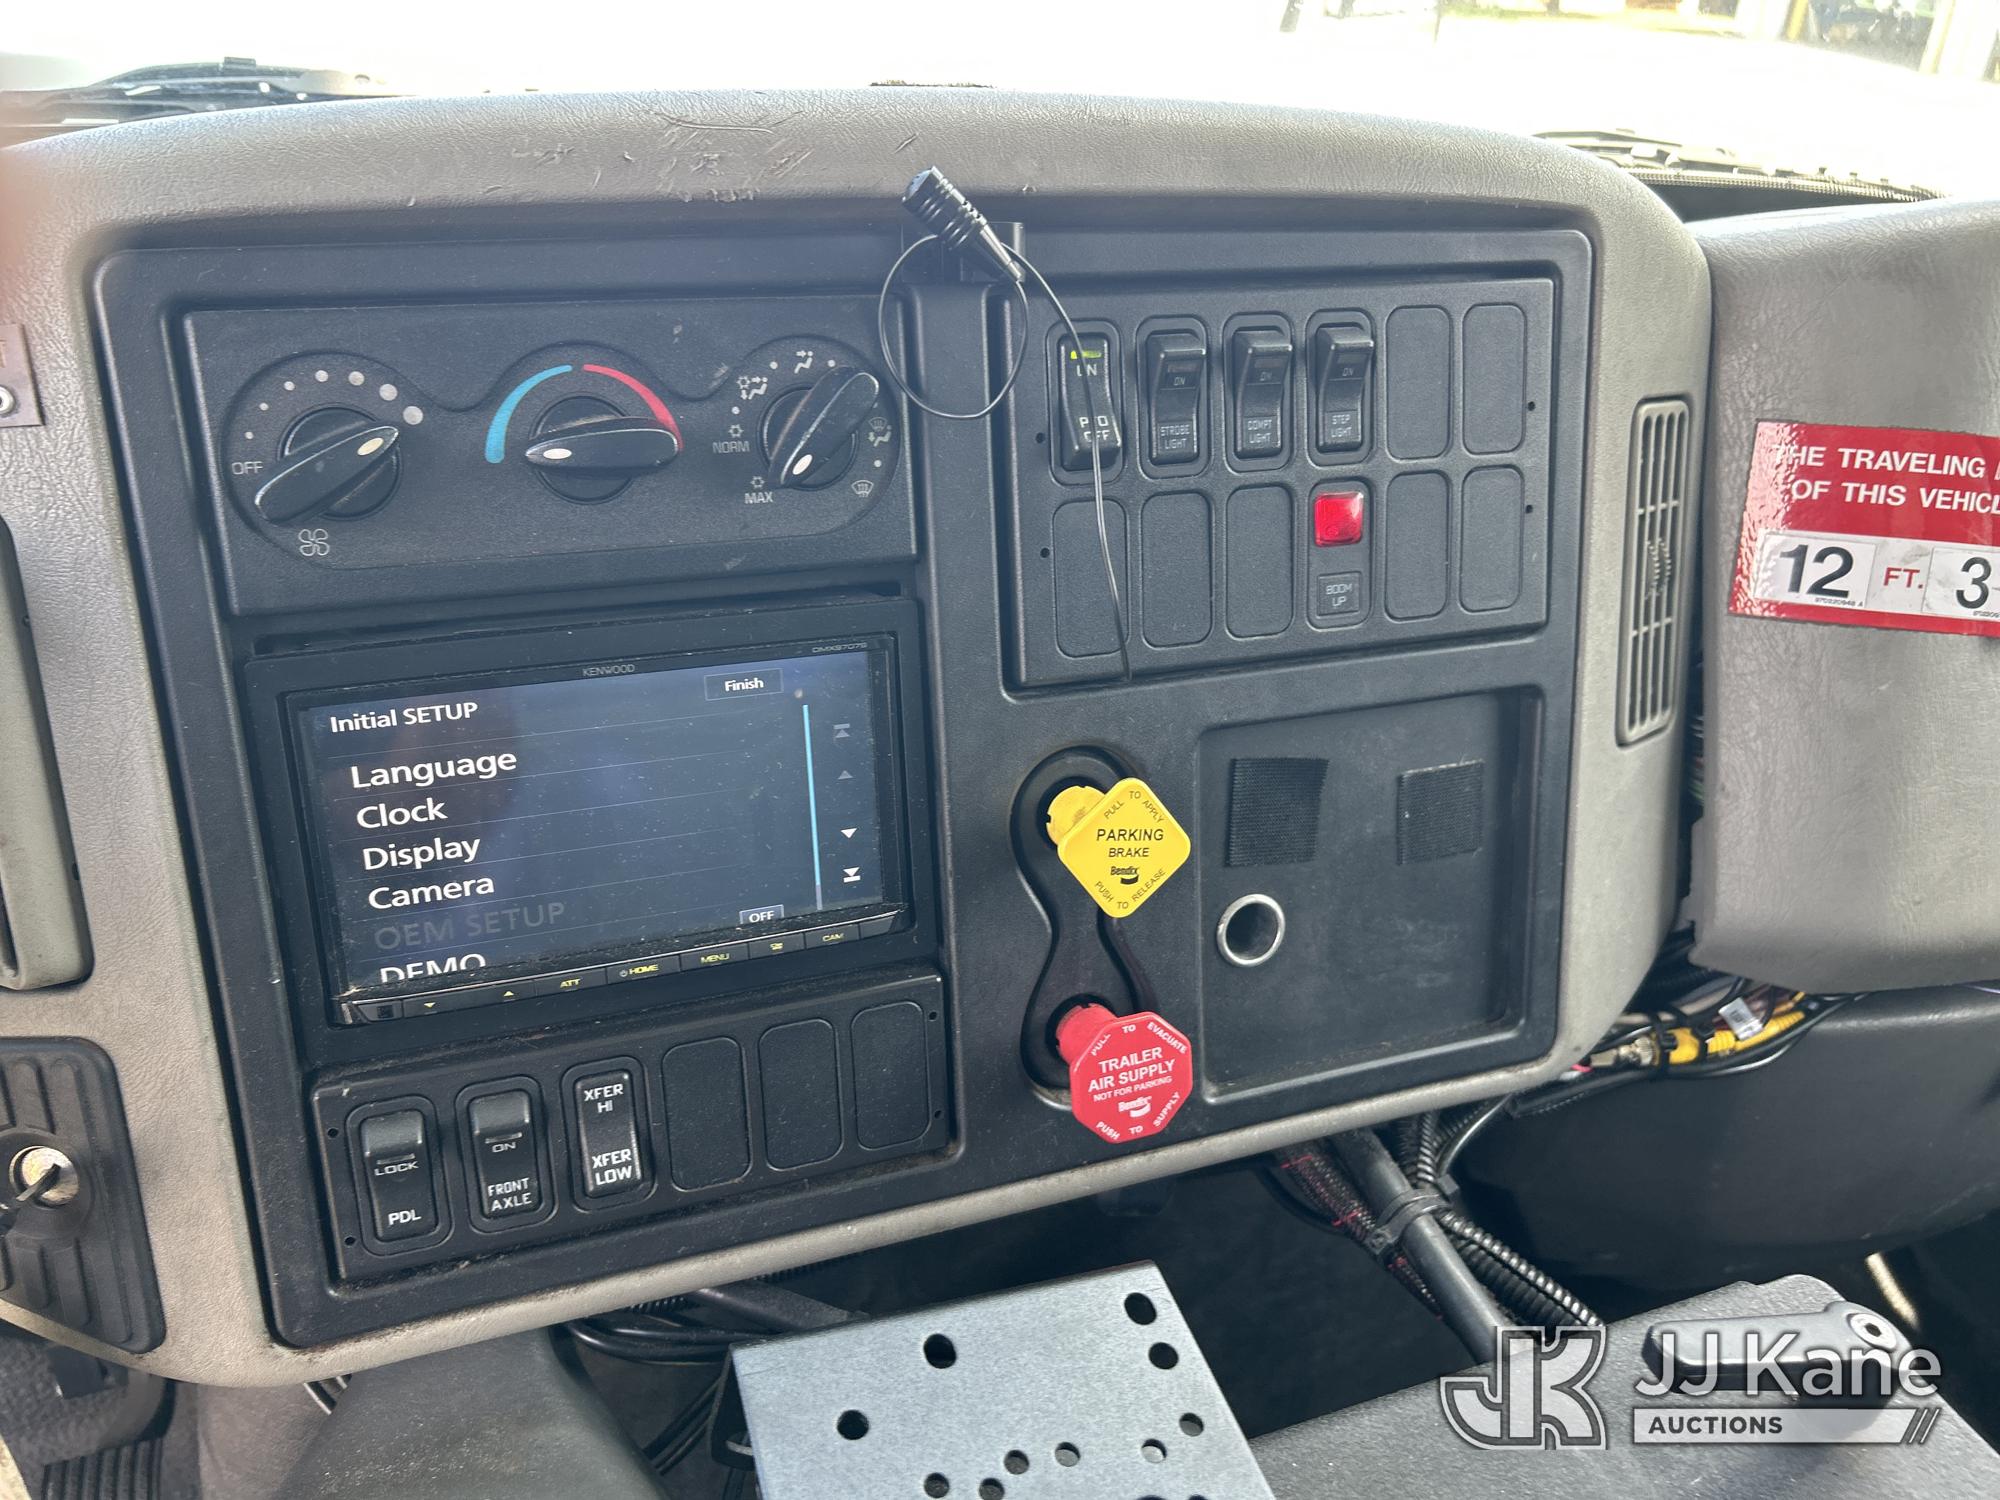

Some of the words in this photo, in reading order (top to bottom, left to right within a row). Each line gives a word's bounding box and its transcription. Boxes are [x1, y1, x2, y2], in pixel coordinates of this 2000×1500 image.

[1260, 371, 1273, 381] ON
[1342, 367, 1354, 377] ON
[1173, 376, 1186, 386] ON
[1079, 415, 1109, 428] PO
[1248, 419, 1273, 431] COMPT
[1332, 413, 1351, 425] STEP
[1160, 424, 1191, 437] STROBE
[1330, 427, 1352, 438] LIGHT
[712, 437, 751, 454] NORM
[1164, 437, 1187, 450] LIGHT
[1249, 433, 1272, 445] LIGHT
[231, 461, 263, 476] OFF
[1772, 445, 1828, 468] THE
[1837, 447, 1986, 479] TRAVELING
[744, 491, 774, 505] MAX
[1791, 479, 1832, 501] OF
[1840, 482, 1907, 507] THIS
[1779, 544, 1854, 599] 12
[1883, 566, 1924, 589] FT.
[1955, 556, 1992, 610] 3
[1325, 583, 1353, 595] BOOM
[1331, 596, 1347, 607] UP
[582, 663, 636, 677] KENWOOD
[724, 678, 765, 692] Finish
[330, 712, 397, 733] Initial
[402, 702, 478, 726] SETUP
[350, 750, 518, 789] Language
[356, 798, 448, 830] Clock
[1103, 800, 1124, 820] PULL
[1129, 791, 1141, 799] TO
[1143, 800, 1165, 823] APPLY
[1096, 828, 1165, 842] PARKING
[362, 836, 481, 871] Display
[1108, 847, 1150, 858] BRAKE
[1110, 866, 1139, 876] Bendix
[367, 876, 495, 910] Camera
[1094, 880, 1114, 903] PUSH
[1116, 901, 1129, 910] TO
[1132, 869, 1166, 901] RELEASE
[748, 910, 775, 923] OFF
[374, 919, 454, 951] OEM
[465, 901, 566, 937] SETUP
[822, 932, 844, 942] CAM
[701, 953, 729, 963] MENU
[379, 953, 486, 983] DEMO
[629, 964, 658, 974] HOME
[560, 978, 581, 989] ATT
[1092, 1034, 1111, 1056] PULL
[1122, 1025, 1136, 1033] TO
[1147, 1022, 1187, 1054] EVACUATE
[1099, 1047, 1162, 1073] TRAILER
[1088, 1075, 1116, 1093] AIR
[1119, 1059, 1175, 1085] SUPPLY
[584, 1083, 623, 1101] XFER
[1093, 1092, 1113, 1102] NOT
[1114, 1087, 1133, 1098] FOR
[1136, 1076, 1172, 1092] PARKING
[597, 1100, 613, 1114] HI
[1096, 1121, 1121, 1141] PUSH
[1129, 1126, 1143, 1135] TO
[1153, 1091, 1181, 1128] SUPPLY
[492, 1141, 516, 1152] ON
[591, 1149, 632, 1170] XFER
[374, 1160, 419, 1177] LOCK
[595, 1165, 632, 1186] LOW
[488, 1177, 530, 1198] FRONT
[491, 1192, 532, 1212] AXLE
[388, 1209, 421, 1226] PDL
